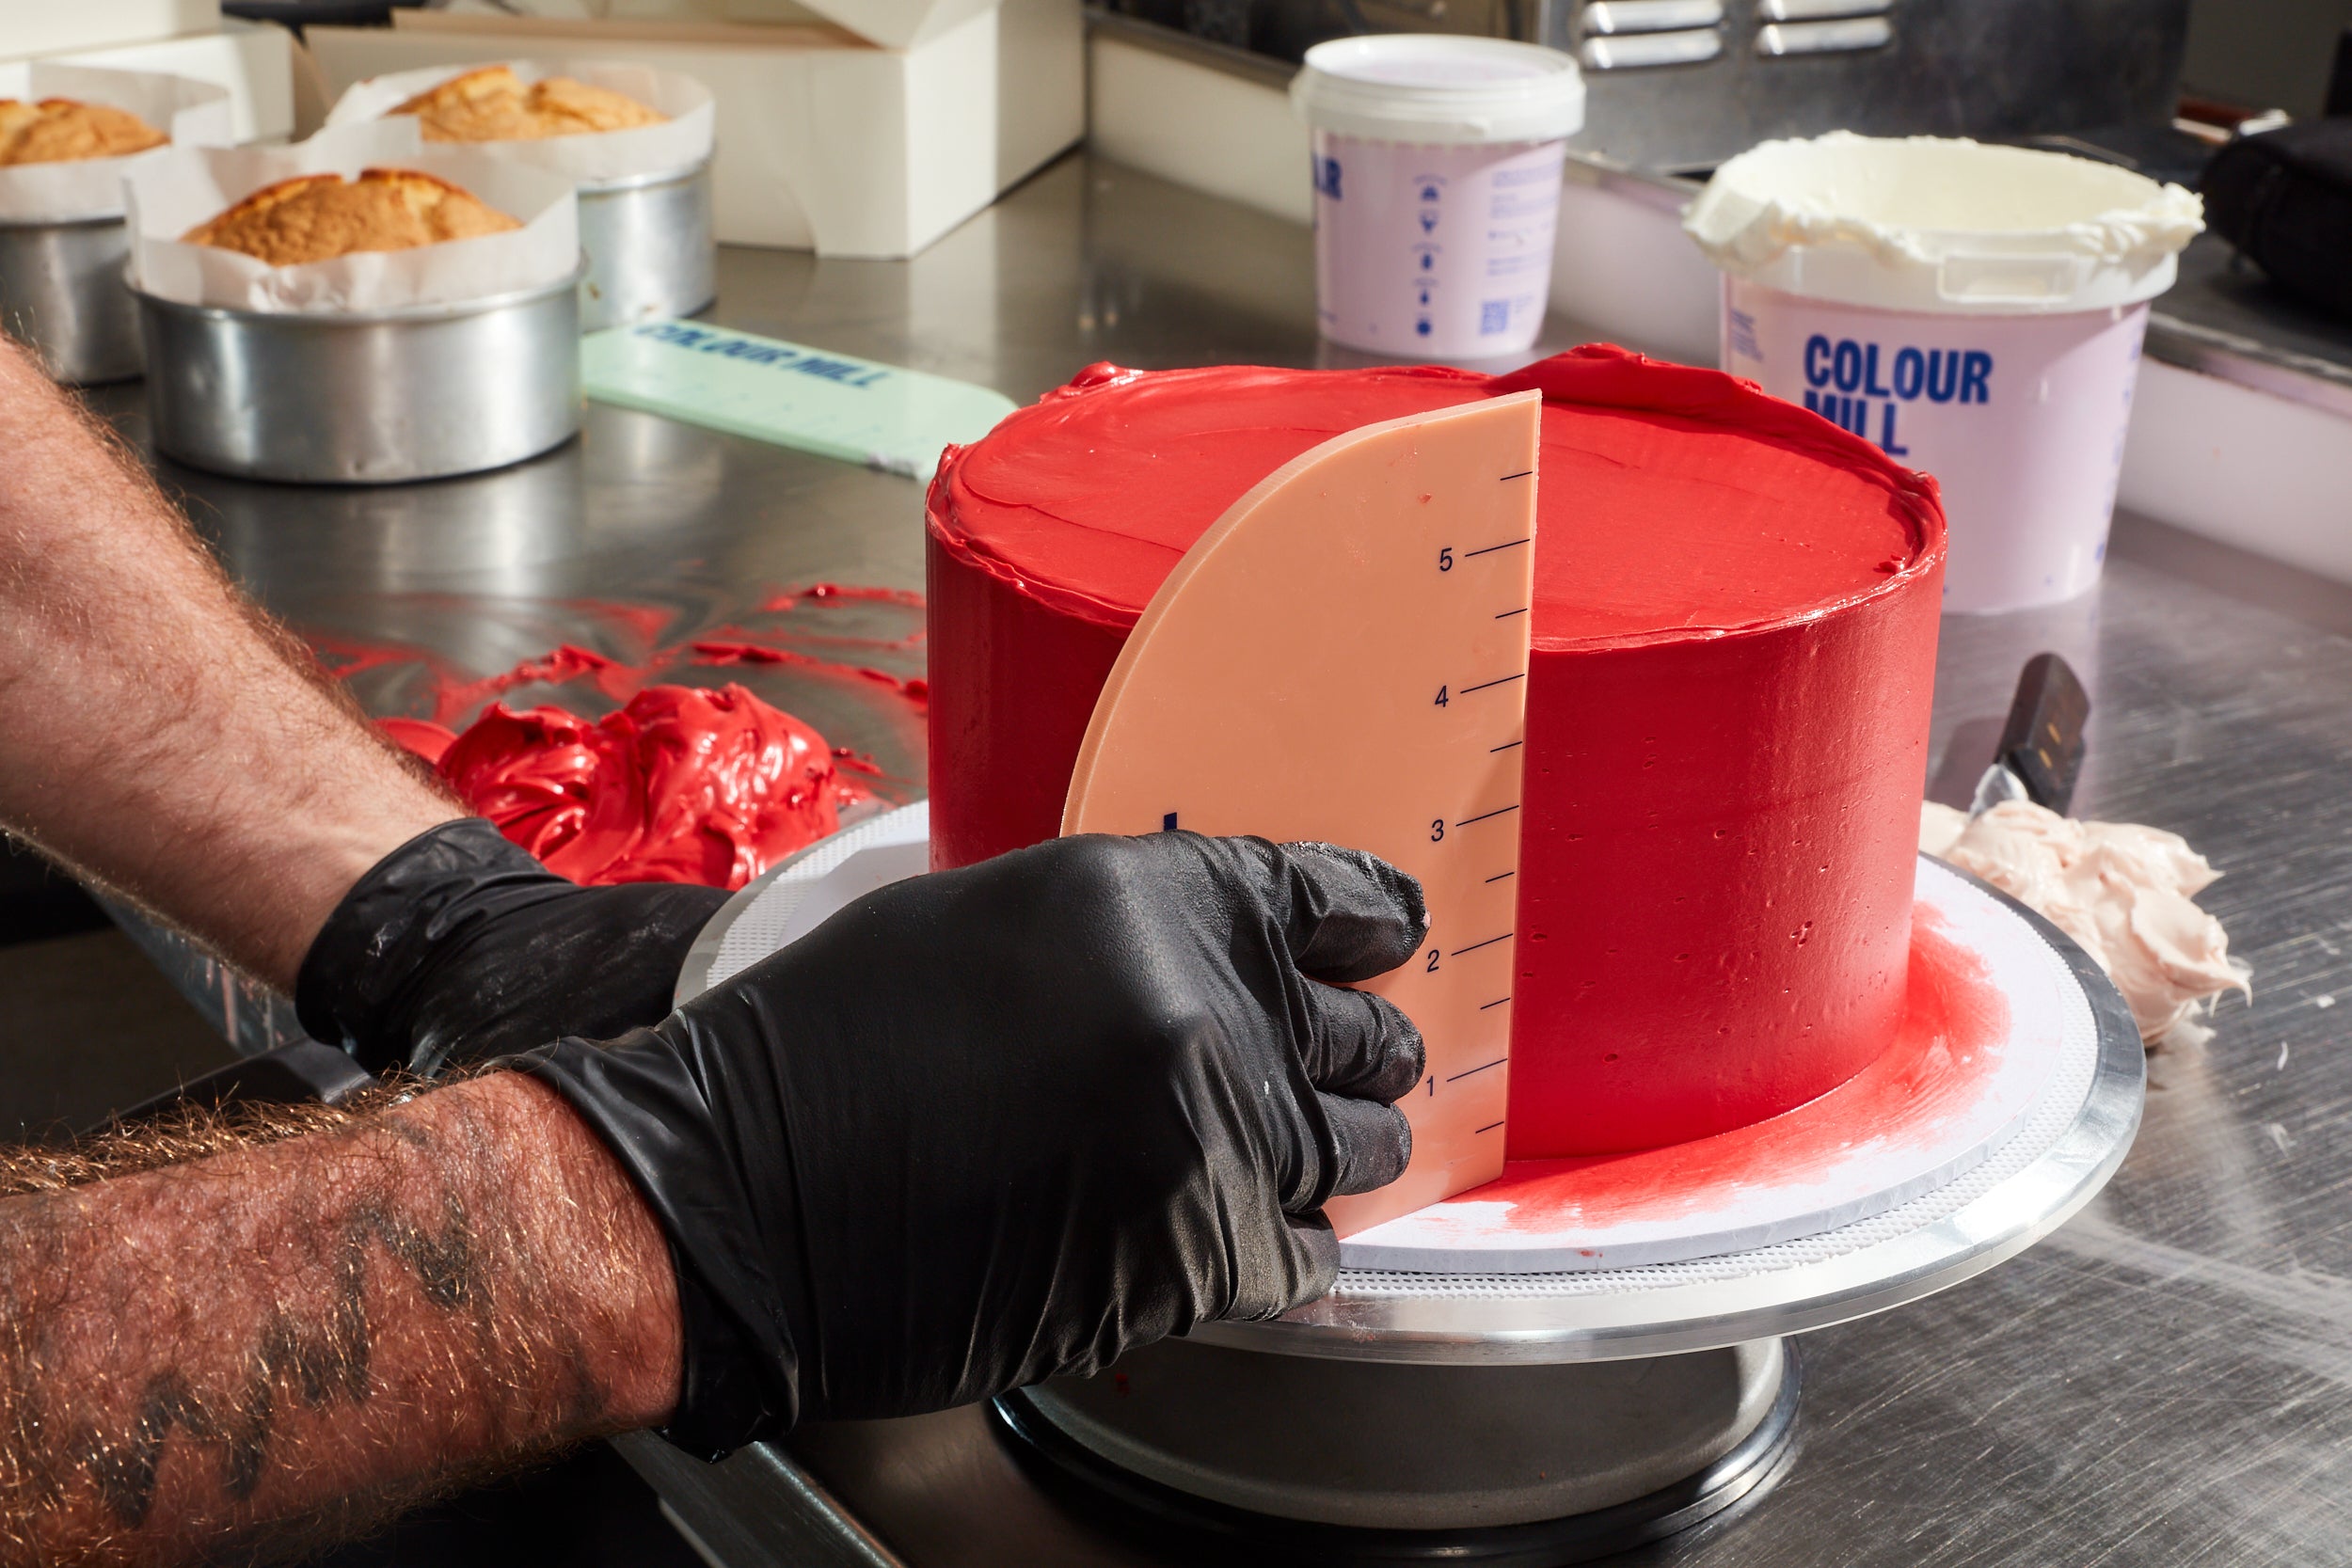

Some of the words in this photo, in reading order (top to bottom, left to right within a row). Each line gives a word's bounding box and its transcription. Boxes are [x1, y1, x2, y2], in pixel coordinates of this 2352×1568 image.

[1804, 333, 1994, 404] COLOUR
[1439, 546, 1454, 572] 5
[1435, 685, 1449, 707] 4
[1431, 818, 1444, 842] 3
[1426, 949, 1440, 973] 2
[1426, 1075, 1434, 1097] 1
